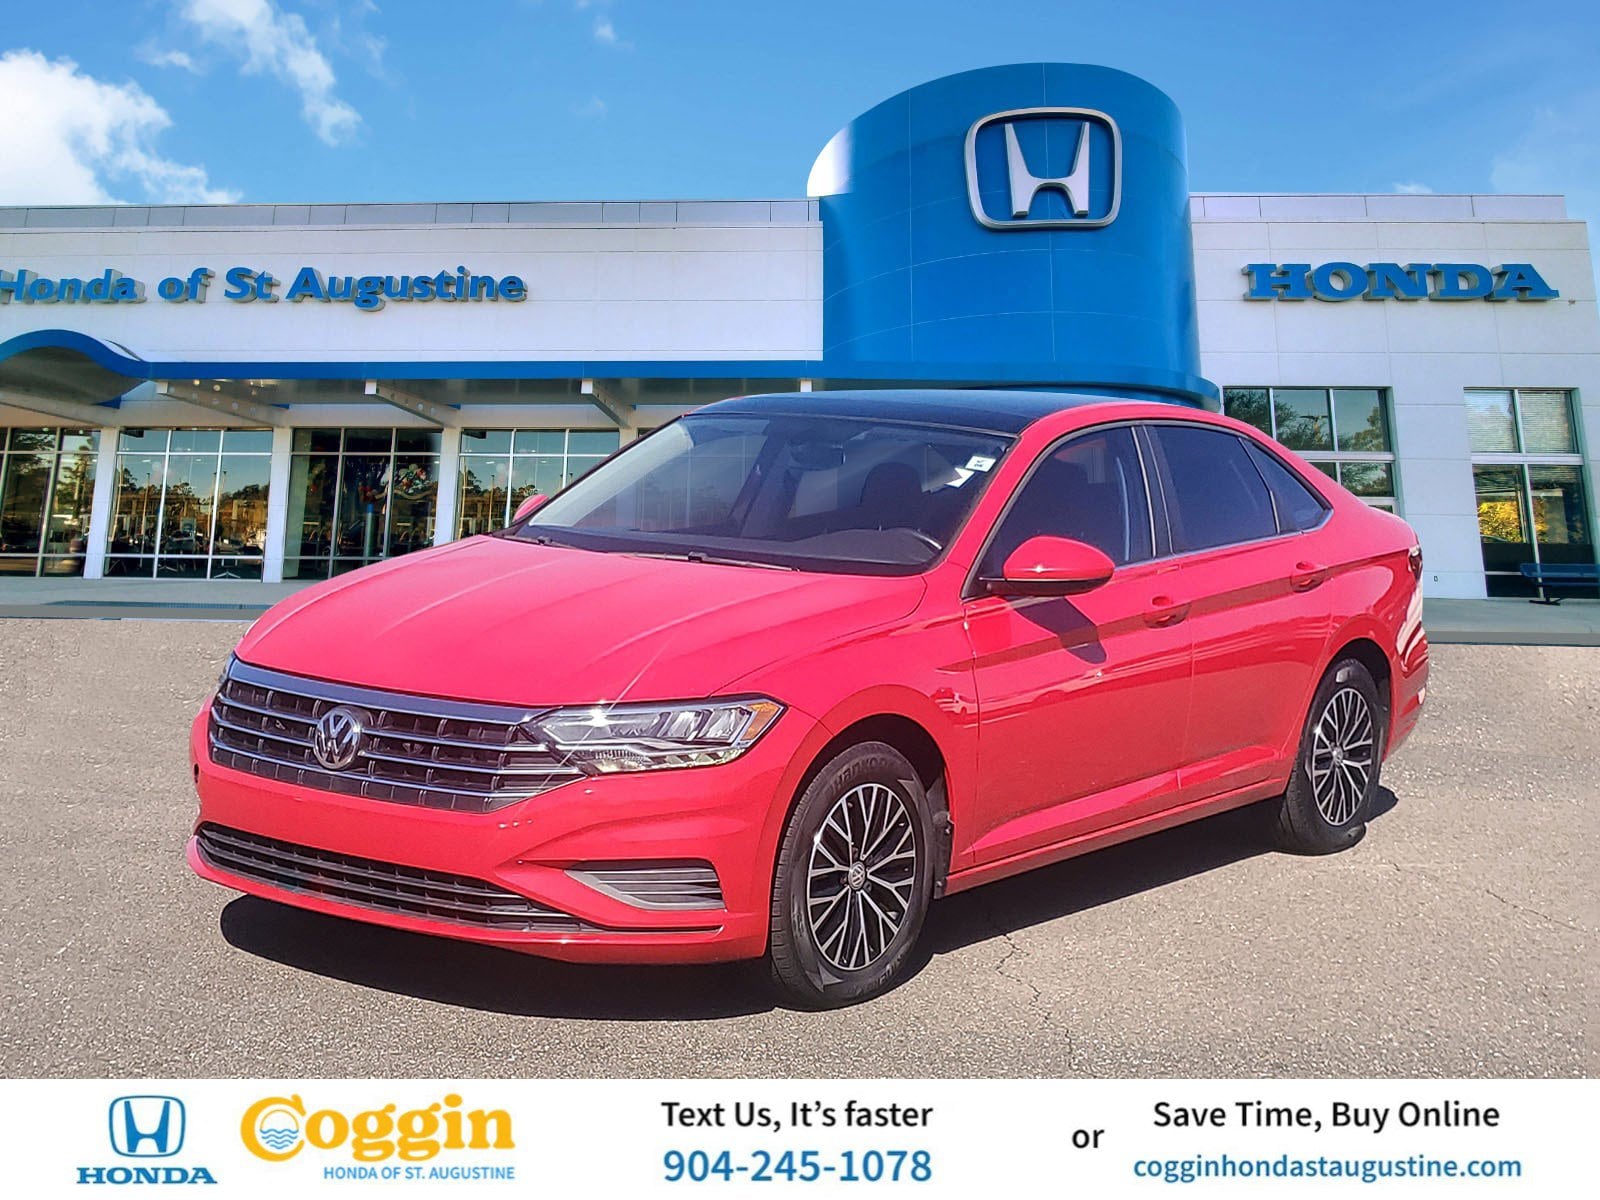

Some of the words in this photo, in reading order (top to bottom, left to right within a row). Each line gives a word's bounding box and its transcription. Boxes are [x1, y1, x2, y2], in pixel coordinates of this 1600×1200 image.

[0, 267, 144, 303] Honda
[157, 266, 213, 302] of
[224, 266, 278, 303] St
[286, 265, 528, 310] Augustine
[1242, 262, 1560, 301] HONDA
